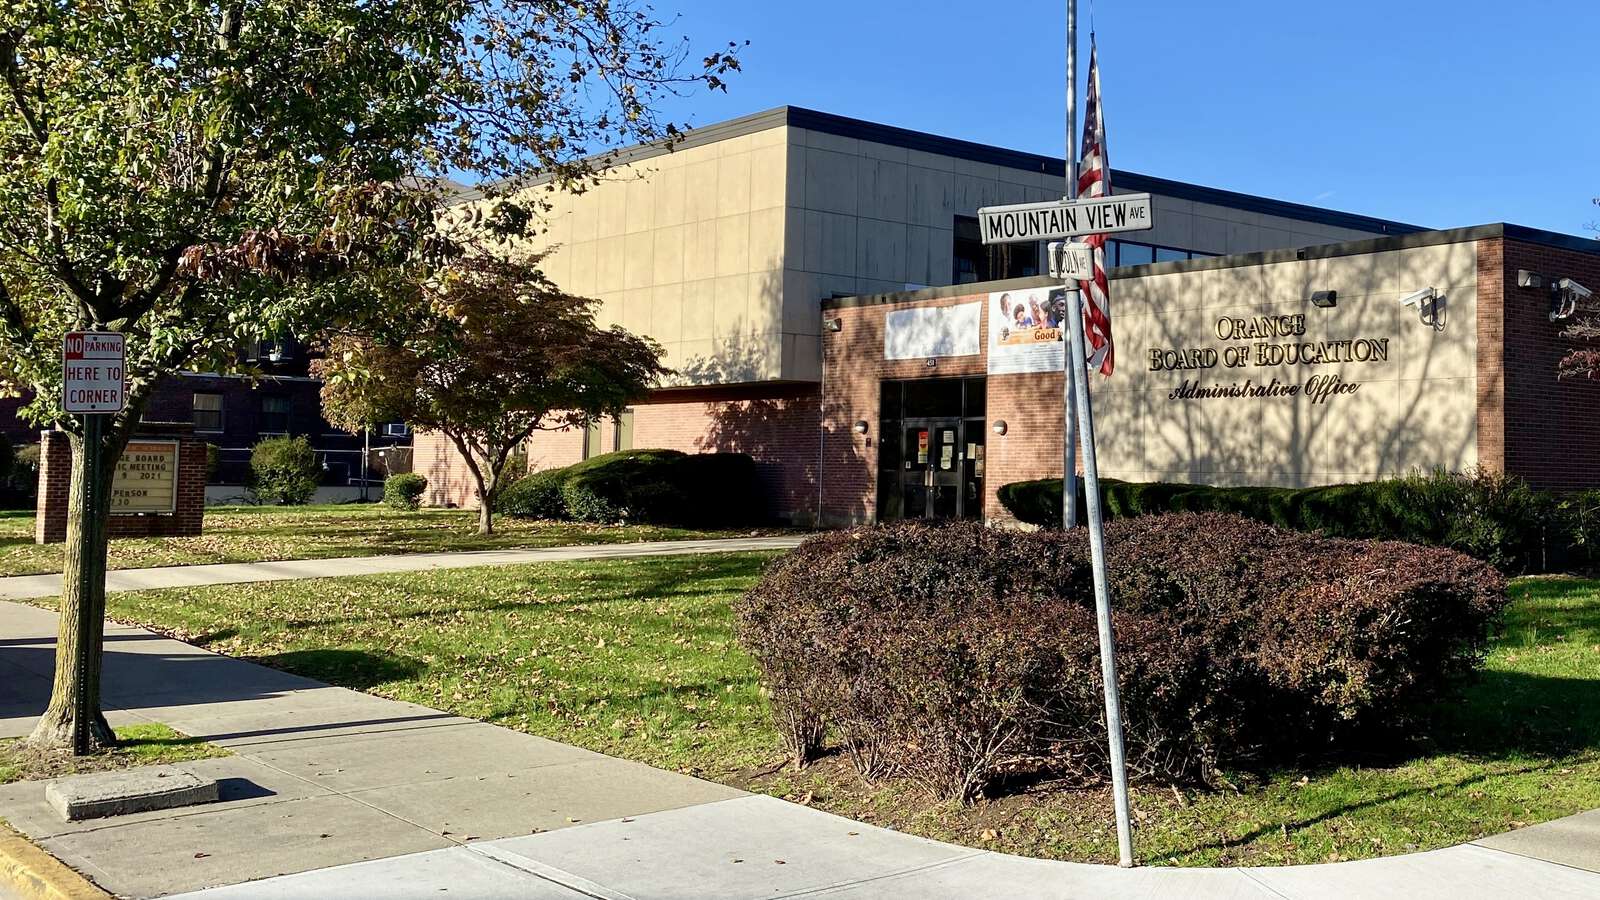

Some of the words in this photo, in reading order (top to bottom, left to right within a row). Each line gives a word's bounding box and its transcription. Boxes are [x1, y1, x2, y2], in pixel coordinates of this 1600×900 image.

[989, 208, 1077, 239] MOUNTAIN
[1086, 203, 1127, 229] VIEW
[1129, 206, 1145, 219] AVE
[1034, 329, 1056, 340] Good
[1214, 314, 1306, 340] ORANGE
[67, 338, 82, 353] NO
[85, 342, 121, 352] PARKING
[1149, 348, 1218, 371] BOARD
[1223, 346, 1249, 368] OF
[1254, 338, 1389, 366] EDUCATION
[68, 367, 100, 380] HERE
[106, 367, 120, 380] TO
[70, 389, 117, 403] CORNER
[1169, 378, 1301, 400] Administrative
[1304, 374, 1361, 404] Office
[113, 489, 148, 497] PERSON
